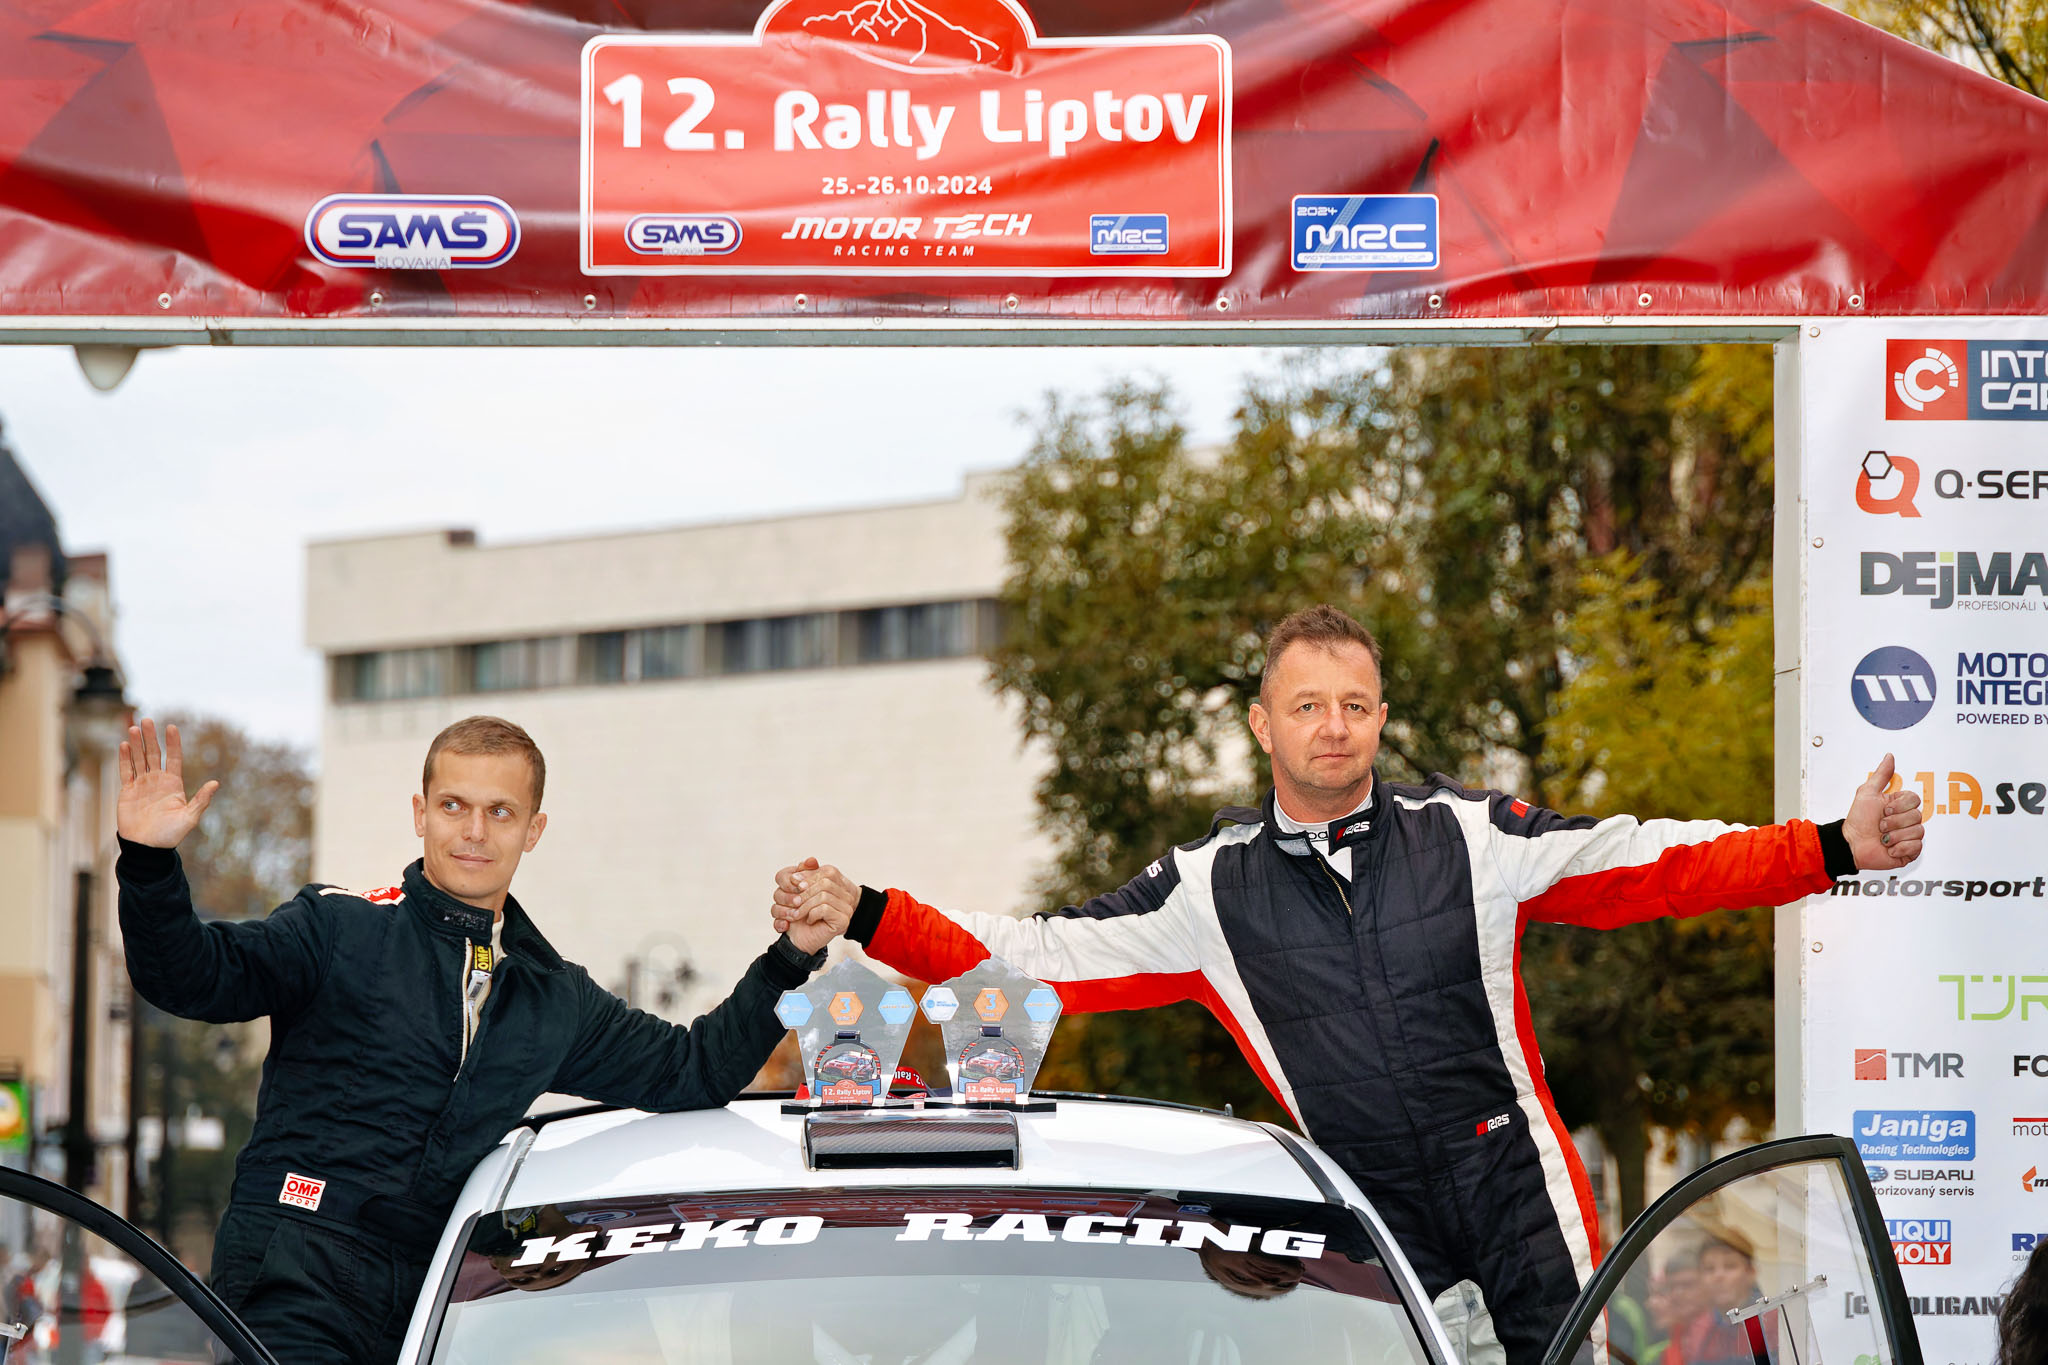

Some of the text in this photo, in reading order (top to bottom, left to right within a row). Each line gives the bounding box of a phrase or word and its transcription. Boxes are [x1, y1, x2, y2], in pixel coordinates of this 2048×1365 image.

[603, 74, 1208, 160] 12. Rally Liptov
[822, 176, 993, 195] 25.-26.10.2024
[1297, 206, 1338, 216] 2024
[338, 211, 487, 249] SAMŠ
[643, 222, 724, 243] SAMŠ
[781, 213, 1033, 240] MOTOR TECH
[1097, 229, 1163, 244] MRC
[1306, 224, 1427, 250] MRC
[834, 245, 976, 257] RACING TEAM
[376, 255, 450, 269] SLOVAKIA
[1981, 350, 2048, 378] INT
[1957, 599, 2037, 611] PROFESIONÁLI
[1957, 679, 2048, 705] INTEG
[1957, 713, 2029, 725] POWERED
[1831, 876, 2046, 902] motorsport
[477, 946, 489, 970] OMP
[840, 997, 851, 1013] 3
[985, 994, 996, 1010] 3
[1891, 1053, 1964, 1078] TMR
[823, 1088, 835, 1096] 12.
[1861, 1113, 1968, 1142] Janiga
[1861, 1143, 1970, 1156] Racing Technologies
[1894, 1169, 1974, 1180] SUBARU
[287, 1180, 320, 1197] OMP
[1940, 1186, 1975, 1196] servis
[282, 1195, 316, 1208] SPORT
[510, 1212, 1327, 1268] KEKO RACING
[1888, 1221, 1949, 1242] LIQUI
